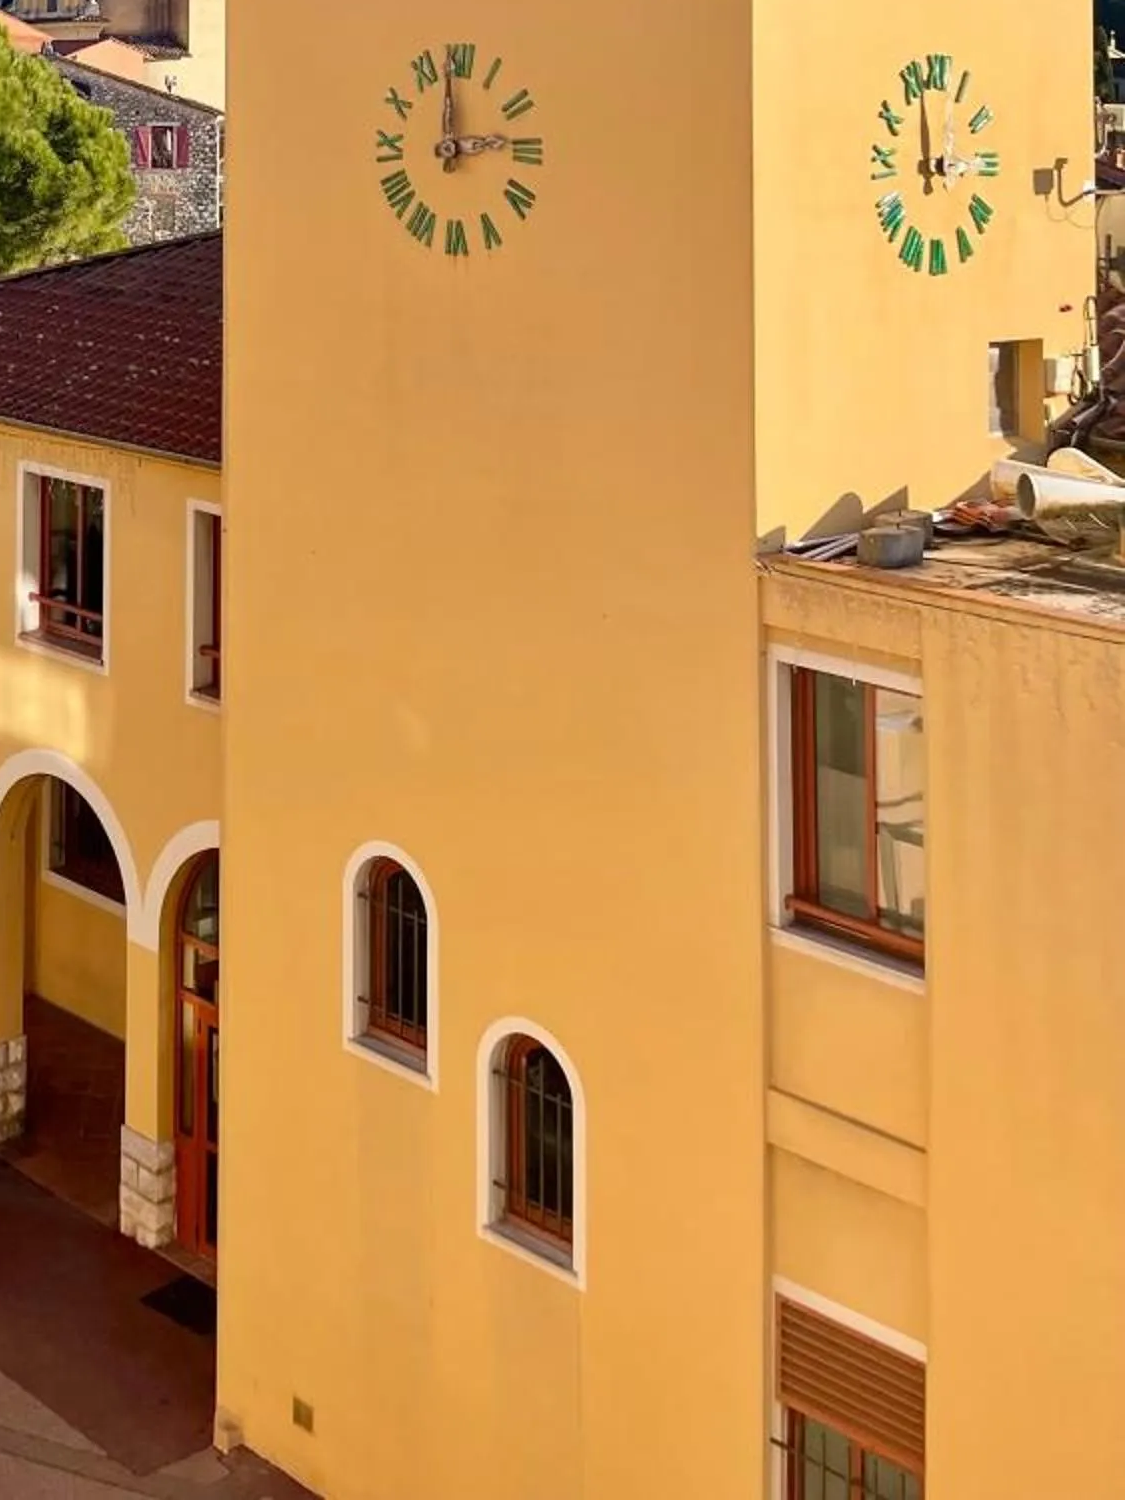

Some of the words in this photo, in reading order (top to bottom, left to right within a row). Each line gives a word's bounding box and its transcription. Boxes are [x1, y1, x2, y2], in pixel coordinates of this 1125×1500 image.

[412, 49, 438, 93] XI
[483, 57, 502, 90] I
[954, 70, 969, 103] I
[385, 87, 412, 120] X
[502, 88, 534, 120] II
[878, 100, 904, 136] X
[376, 129, 404, 163] IX
[512, 138, 543, 165] III
[870, 144, 898, 181] IX
[504, 178, 537, 220] IV
[444, 219, 469, 256] VI
[480, 212, 503, 250] V
[956, 226, 974, 263] V
